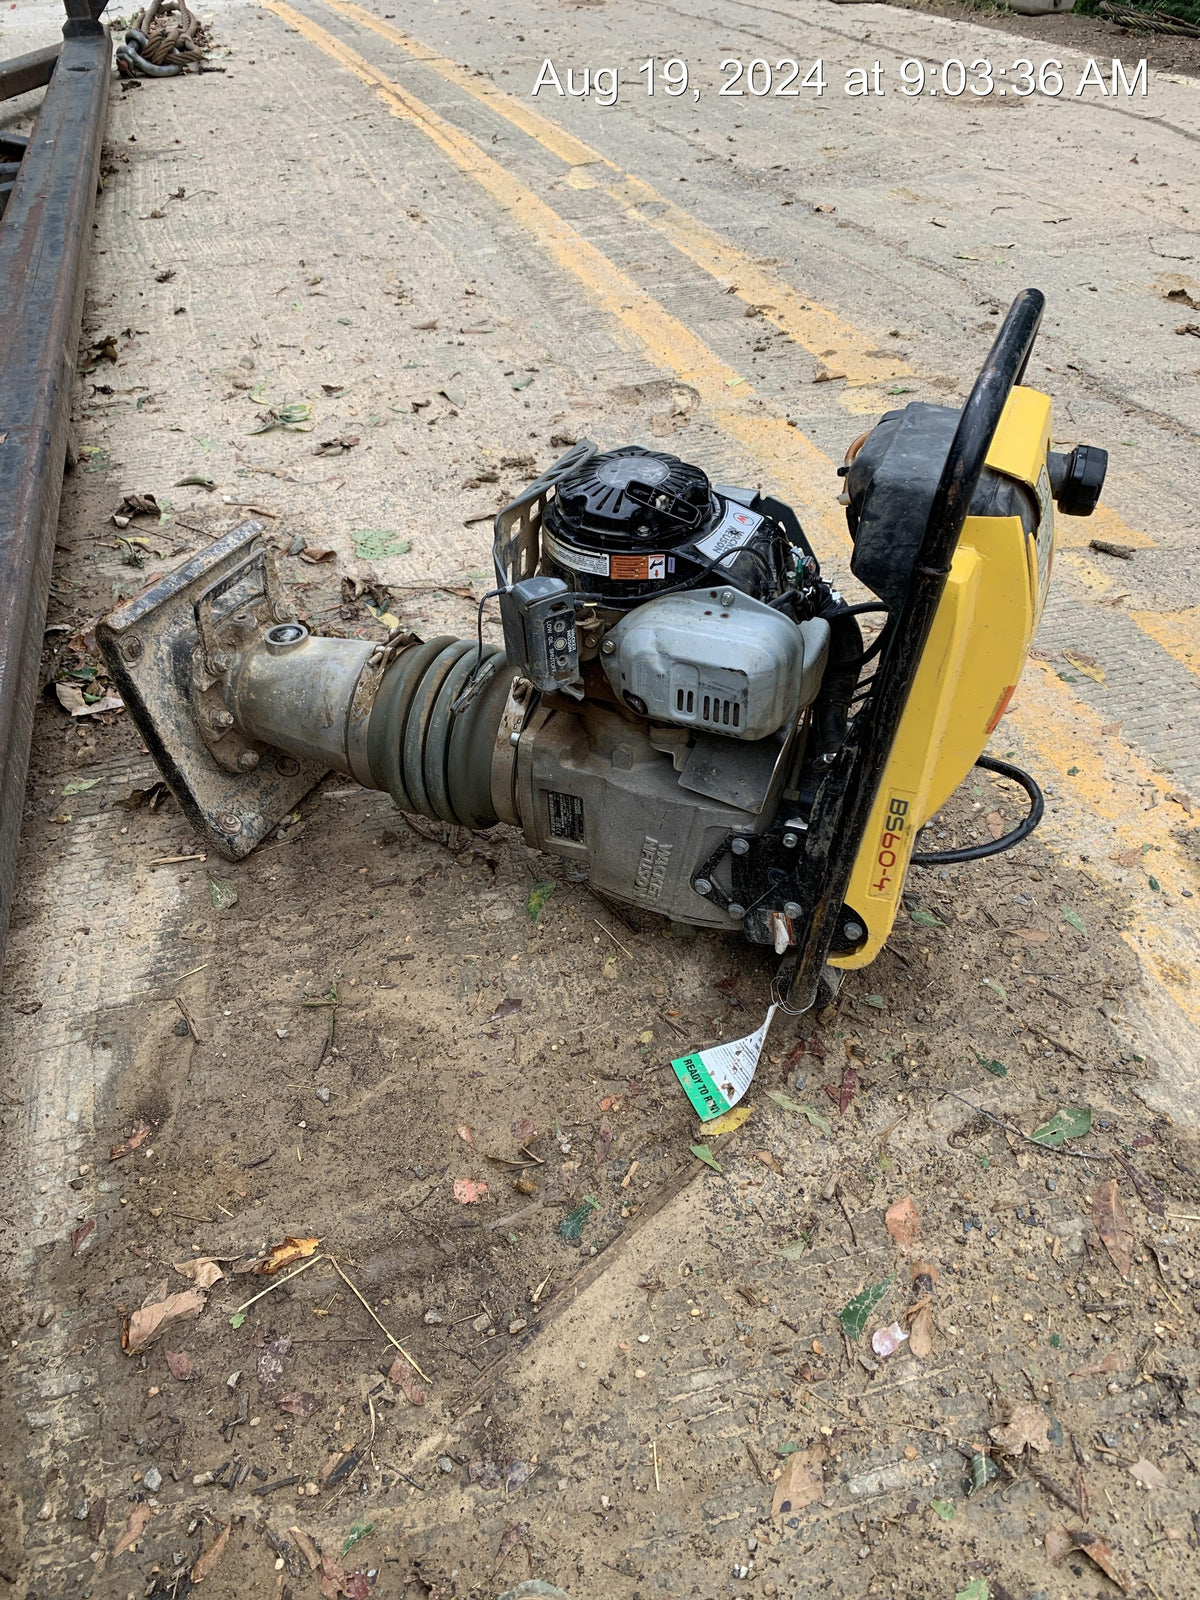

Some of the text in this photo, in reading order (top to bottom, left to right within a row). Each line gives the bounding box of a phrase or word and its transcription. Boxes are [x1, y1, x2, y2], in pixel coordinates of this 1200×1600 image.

[712, 525, 737, 554] NEUSON
[722, 531, 745, 554] WACKE
[633, 835, 659, 900] NEUSON
[872, 798, 909, 892] BS60-4
[647, 844, 673, 904] WACKER
[683, 1058, 704, 1085] READY
[697, 1084, 709, 1096] TO
